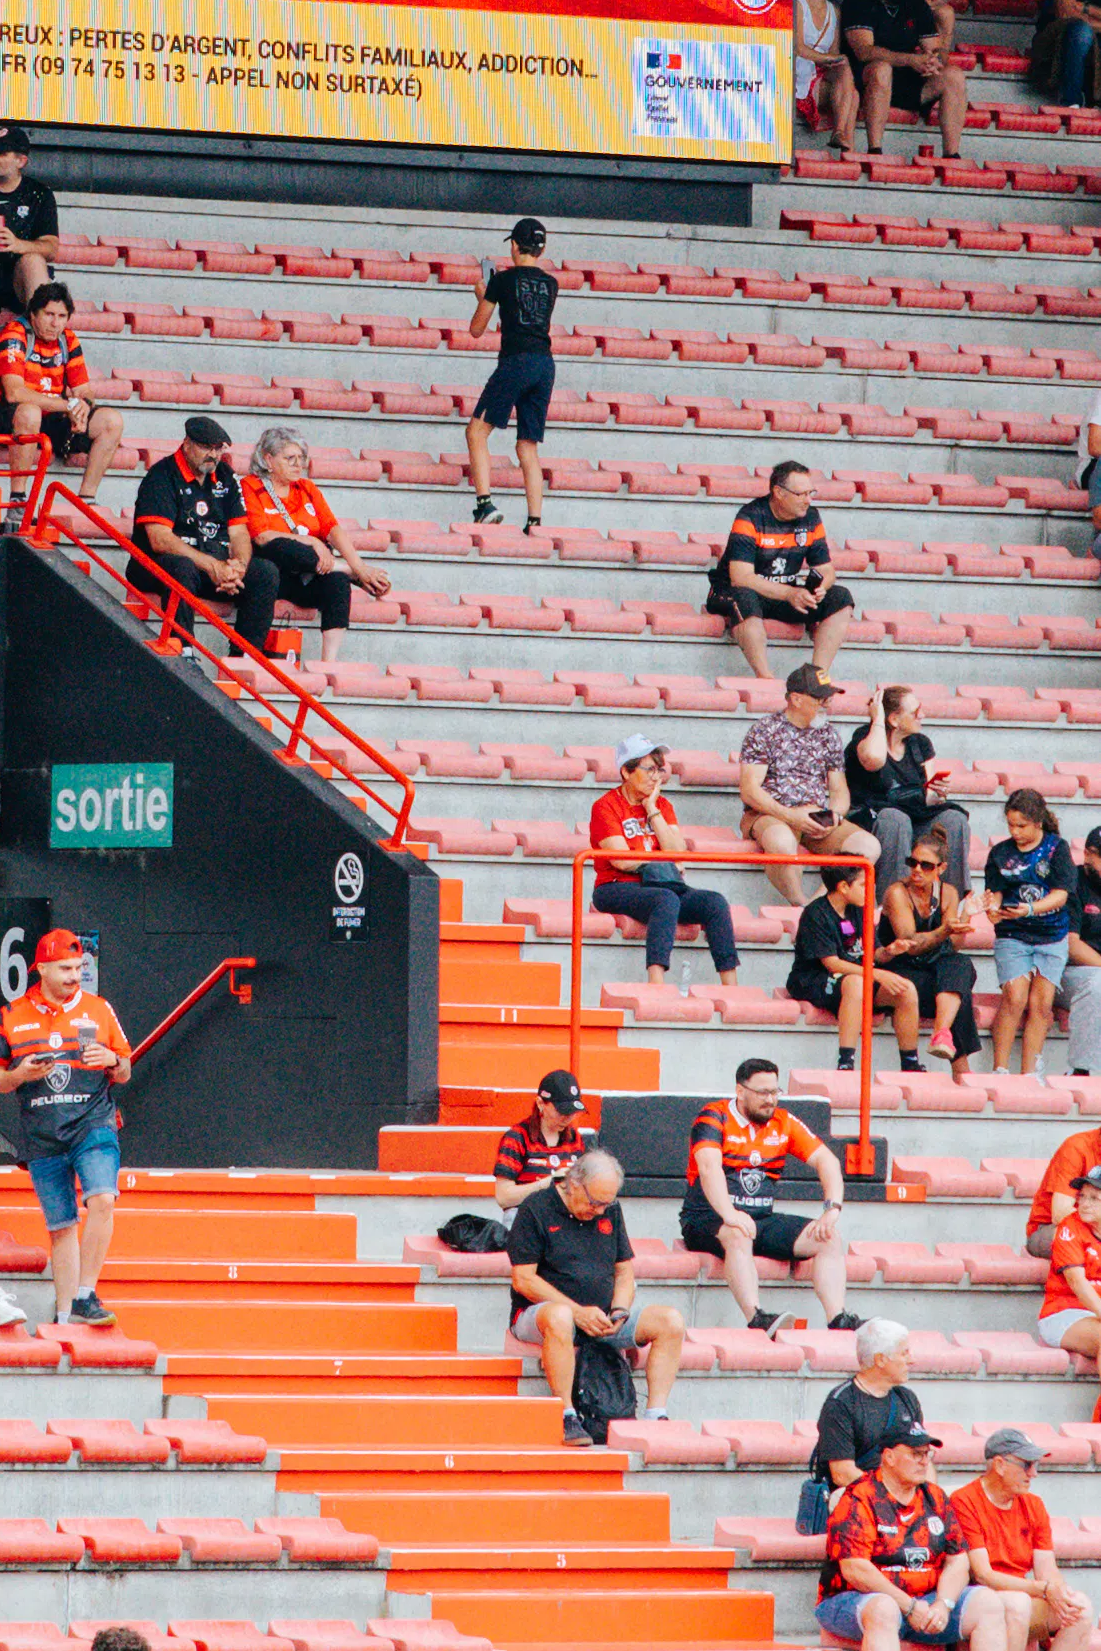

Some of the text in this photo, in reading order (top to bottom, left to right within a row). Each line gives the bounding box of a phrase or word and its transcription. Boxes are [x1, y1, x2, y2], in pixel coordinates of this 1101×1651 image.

[69, 27, 145, 52] PERTES
[151, 33, 252, 59] D'ARGENT,
[258, 40, 355, 65] CONFLITS
[360, 45, 473, 74] FAMILIAUX,
[33, 57, 65, 79] (09
[71, 58, 95, 78] 74
[102, 60, 125, 80] 75
[133, 61, 156, 81] 13
[163, 63, 186, 83] 13
[206, 66, 270, 89] APPEL
[276, 70, 320, 92] NON
[326, 73, 423, 101] SURTAXÉ)
[644, 74, 763, 94] GOUVERNEMENT
[55, 773, 169, 833] sortie
[0, 926, 28, 1003] 6
[501, 1008, 518, 1023] 11
[30, 1094, 91, 1109] PEUGEOT
[227, 1265, 239, 1279] 8
[333, 1360, 344, 1375] 7
[444, 1454, 455, 1469] 6
